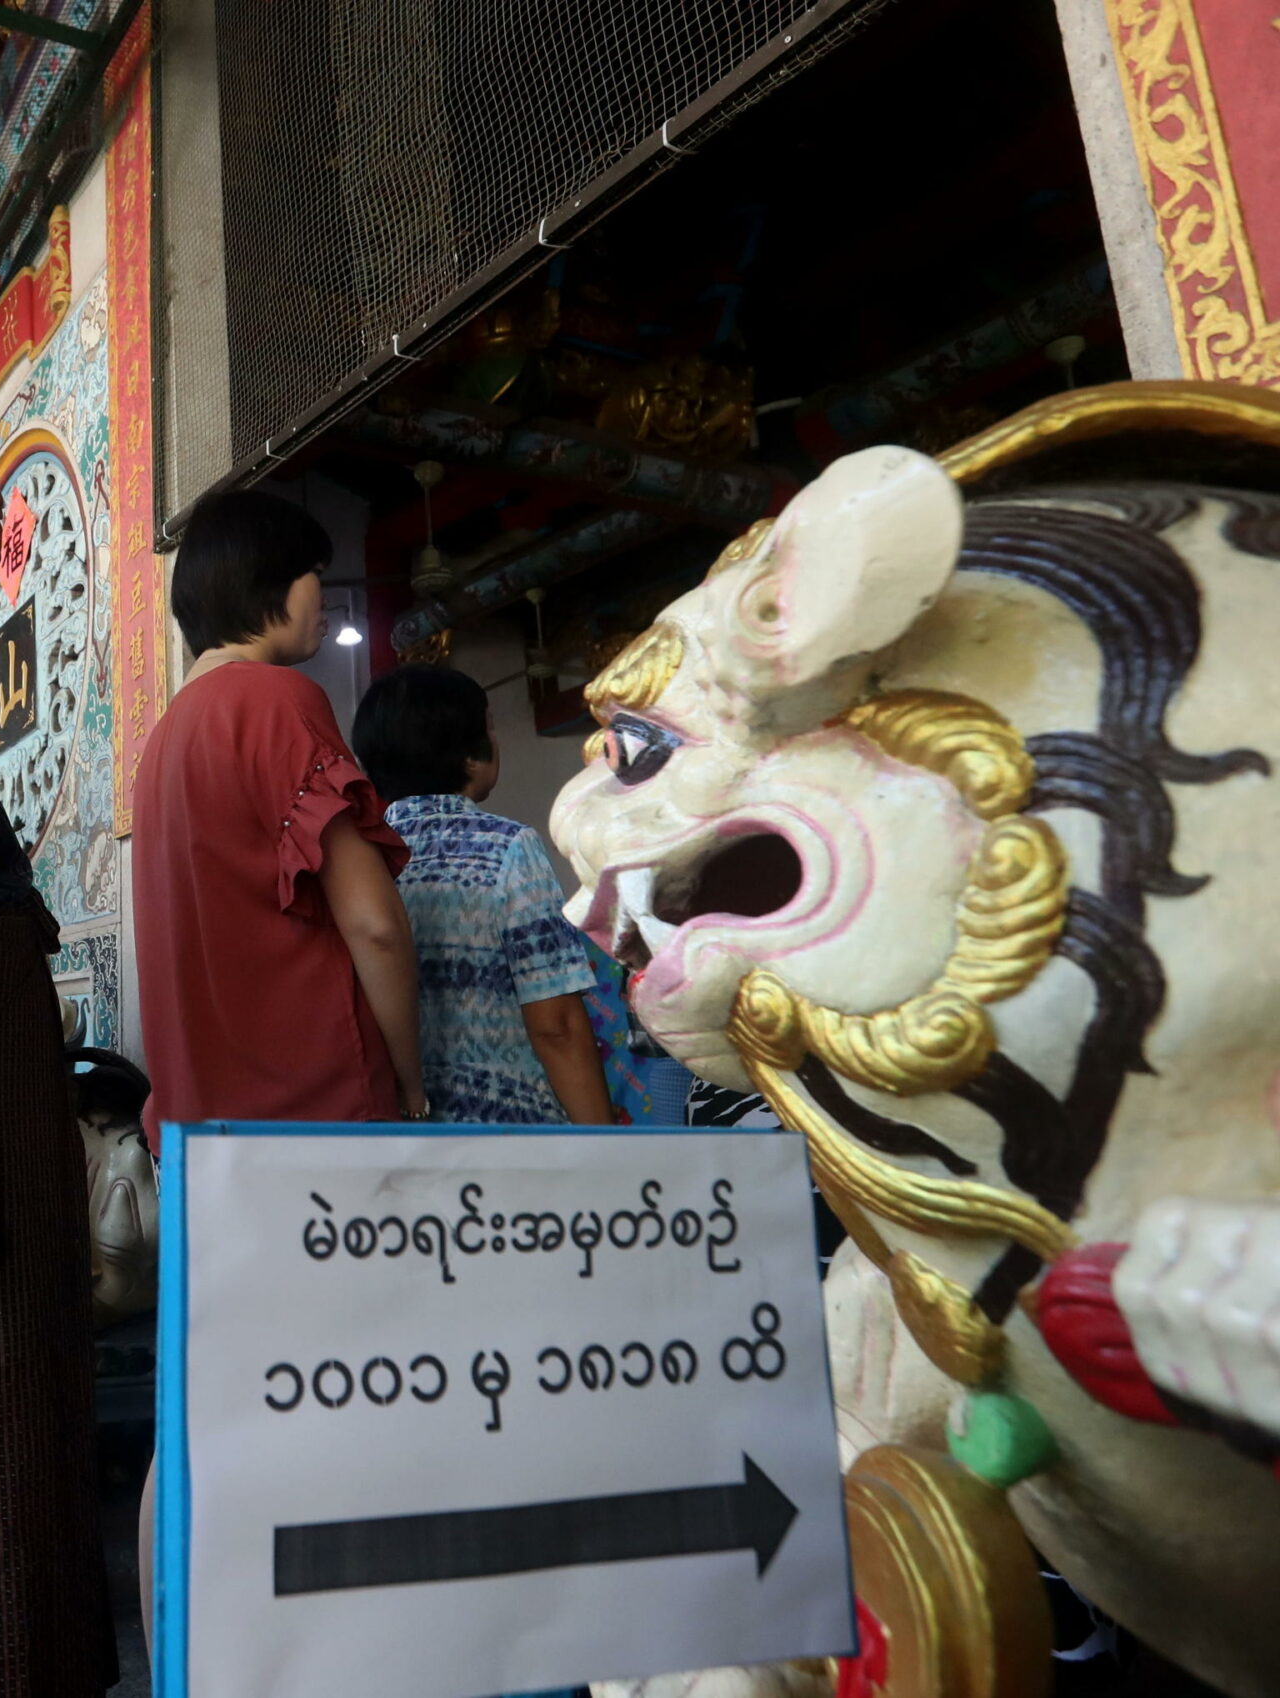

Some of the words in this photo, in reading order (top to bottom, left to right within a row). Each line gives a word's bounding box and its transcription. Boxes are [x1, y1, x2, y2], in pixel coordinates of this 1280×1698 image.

[3, 514, 25, 578] 福
[266, 1355, 447, 1411] ၁၀၀၁
[472, 1351, 510, 1432] မှ
[538, 1340, 698, 1394] ၁၈၁၈
[721, 1302, 787, 1382] ထိ
